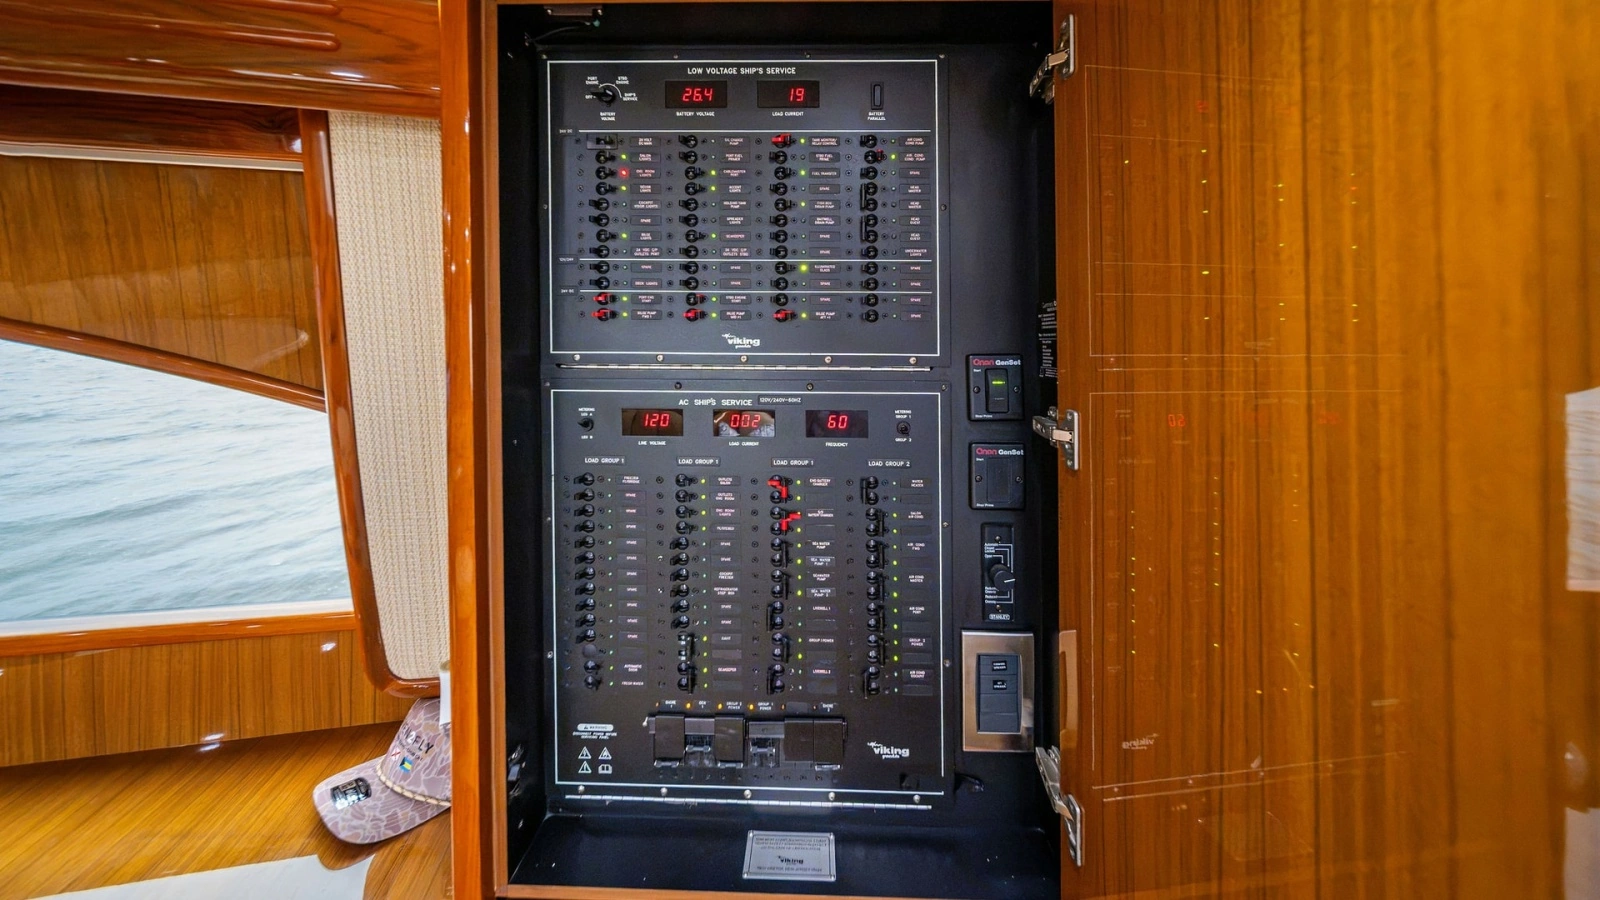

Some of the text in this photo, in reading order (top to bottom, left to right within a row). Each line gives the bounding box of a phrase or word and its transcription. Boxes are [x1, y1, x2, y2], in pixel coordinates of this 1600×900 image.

[790, 88, 805, 102] 19
[727, 337, 760, 346] viking
[973, 358, 1021, 366] Onan GenSet
[678, 398, 752, 406] AC SHIP'S SERVICE
[644, 413, 670, 427] 120
[730, 414, 760, 428] 002
[827, 415, 848, 429] 60
[976, 447, 1024, 455] Onan GenSet
[872, 746, 910, 757] viking
